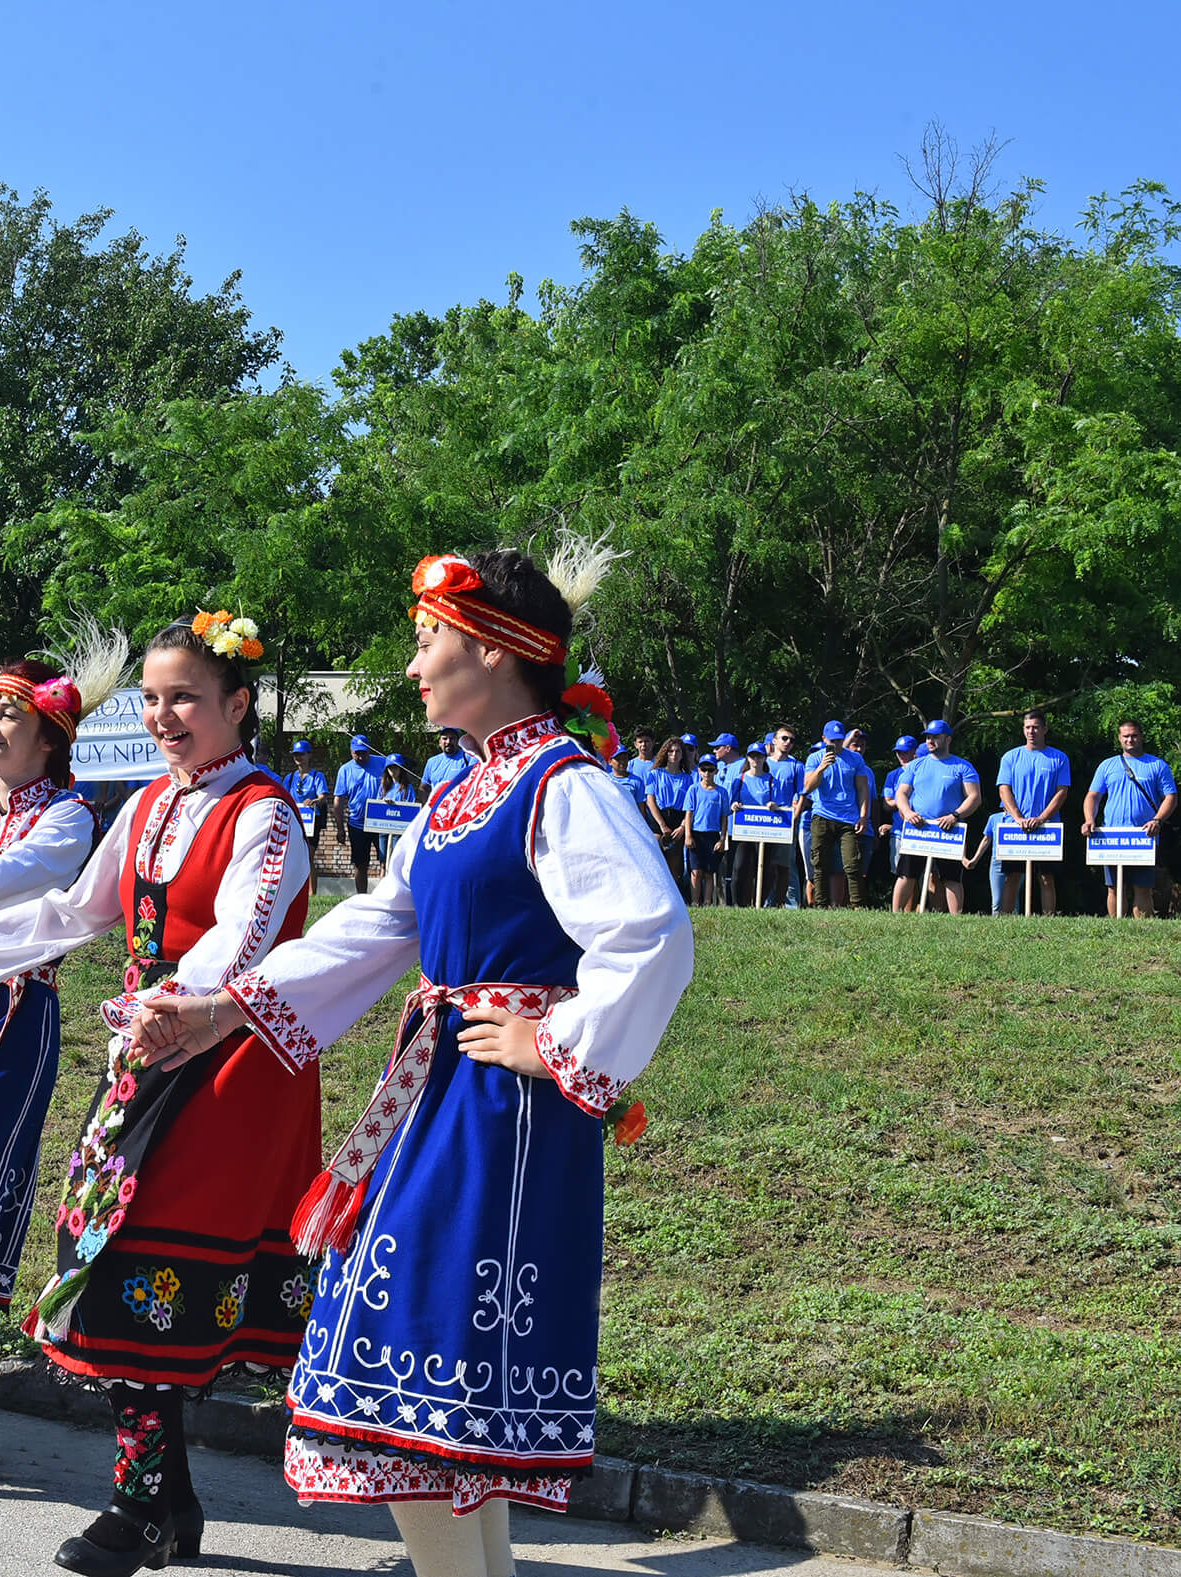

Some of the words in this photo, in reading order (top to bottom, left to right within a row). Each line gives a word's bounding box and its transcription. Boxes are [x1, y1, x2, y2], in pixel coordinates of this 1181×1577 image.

[71, 743, 106, 763] UY
[114, 743, 157, 762] NPP
[941, 832, 963, 842] БОРБА
